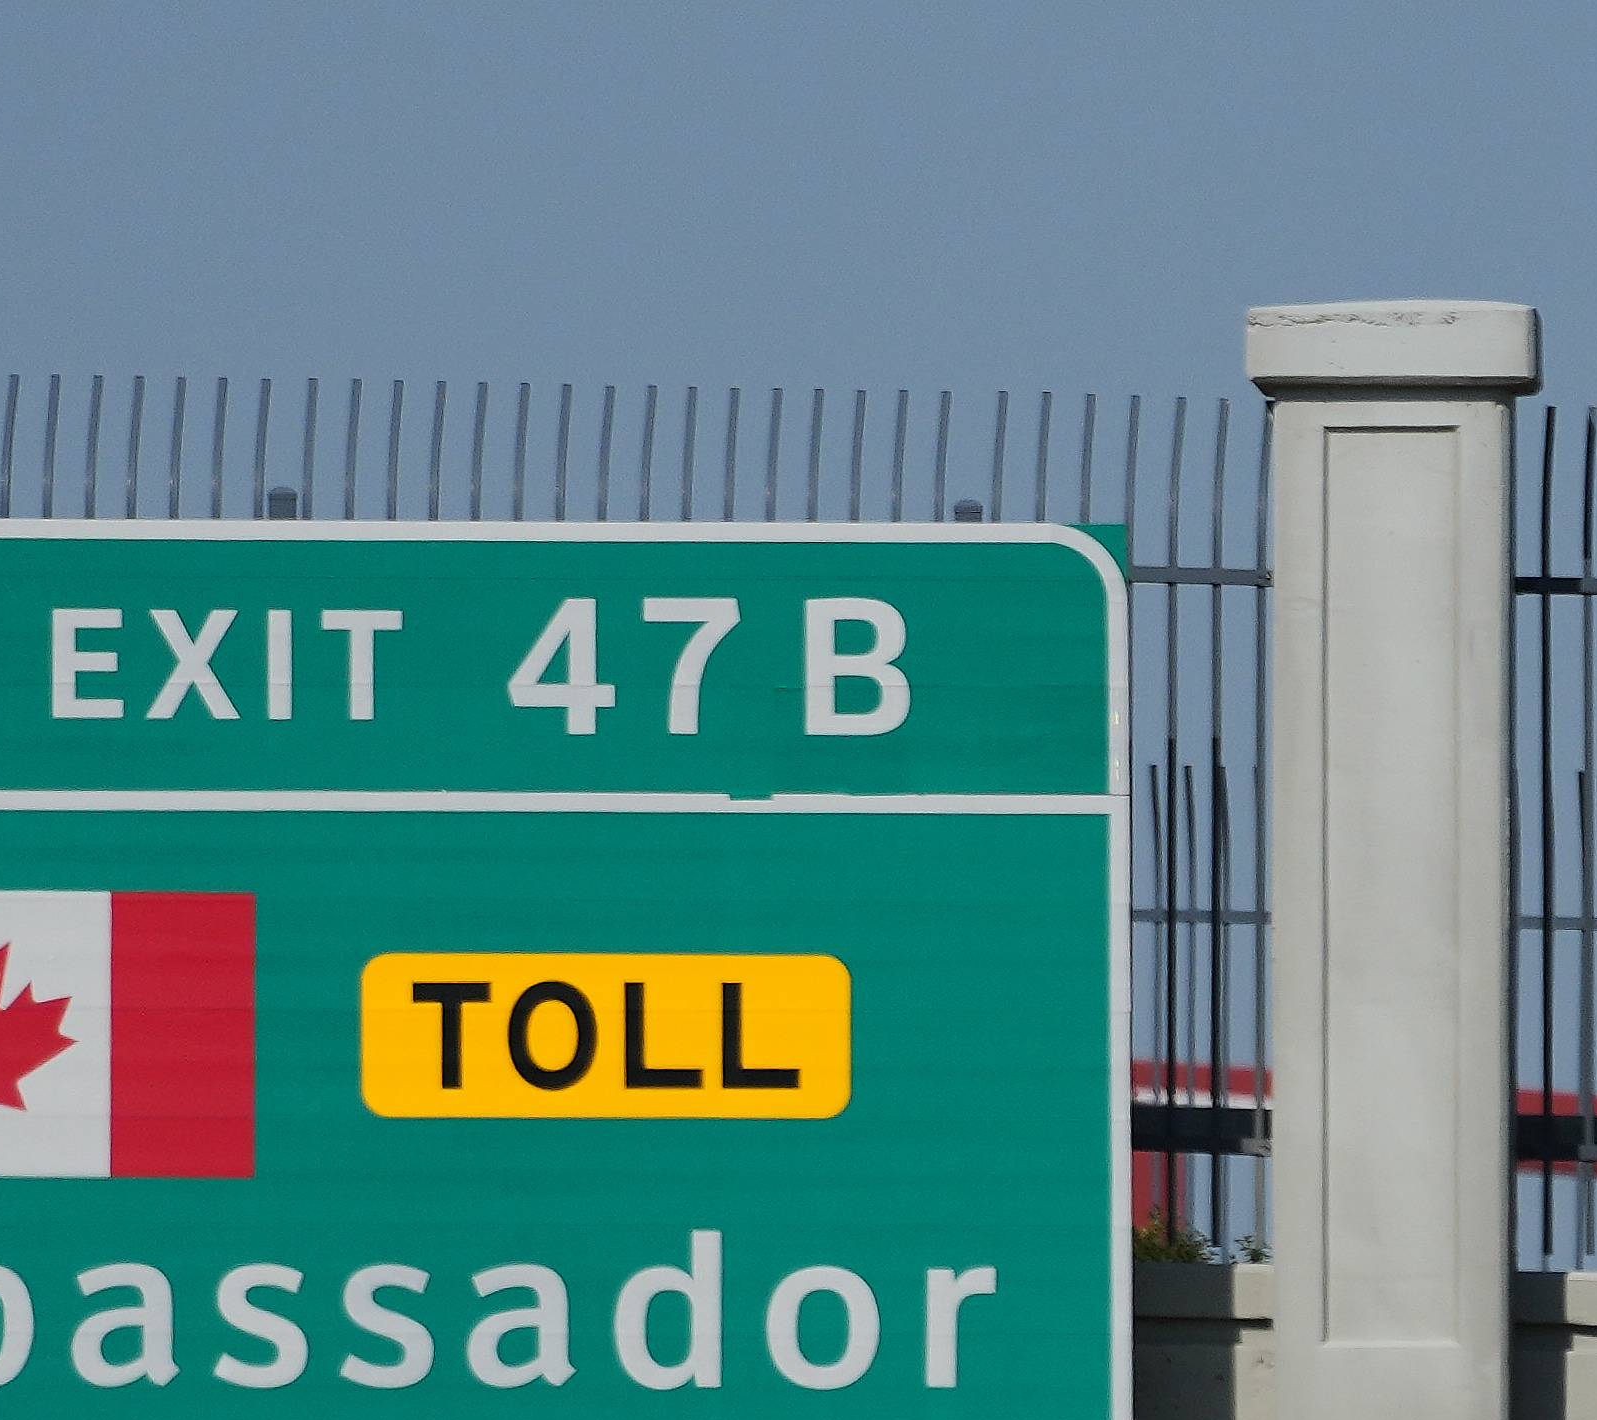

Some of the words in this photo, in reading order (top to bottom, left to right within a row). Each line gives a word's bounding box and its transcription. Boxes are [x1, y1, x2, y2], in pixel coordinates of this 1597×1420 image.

[50, 607, 404, 721] EXIT
[506, 596, 742, 736] 47
[803, 596, 912, 737] B
[411, 980, 801, 1092] TOLL
